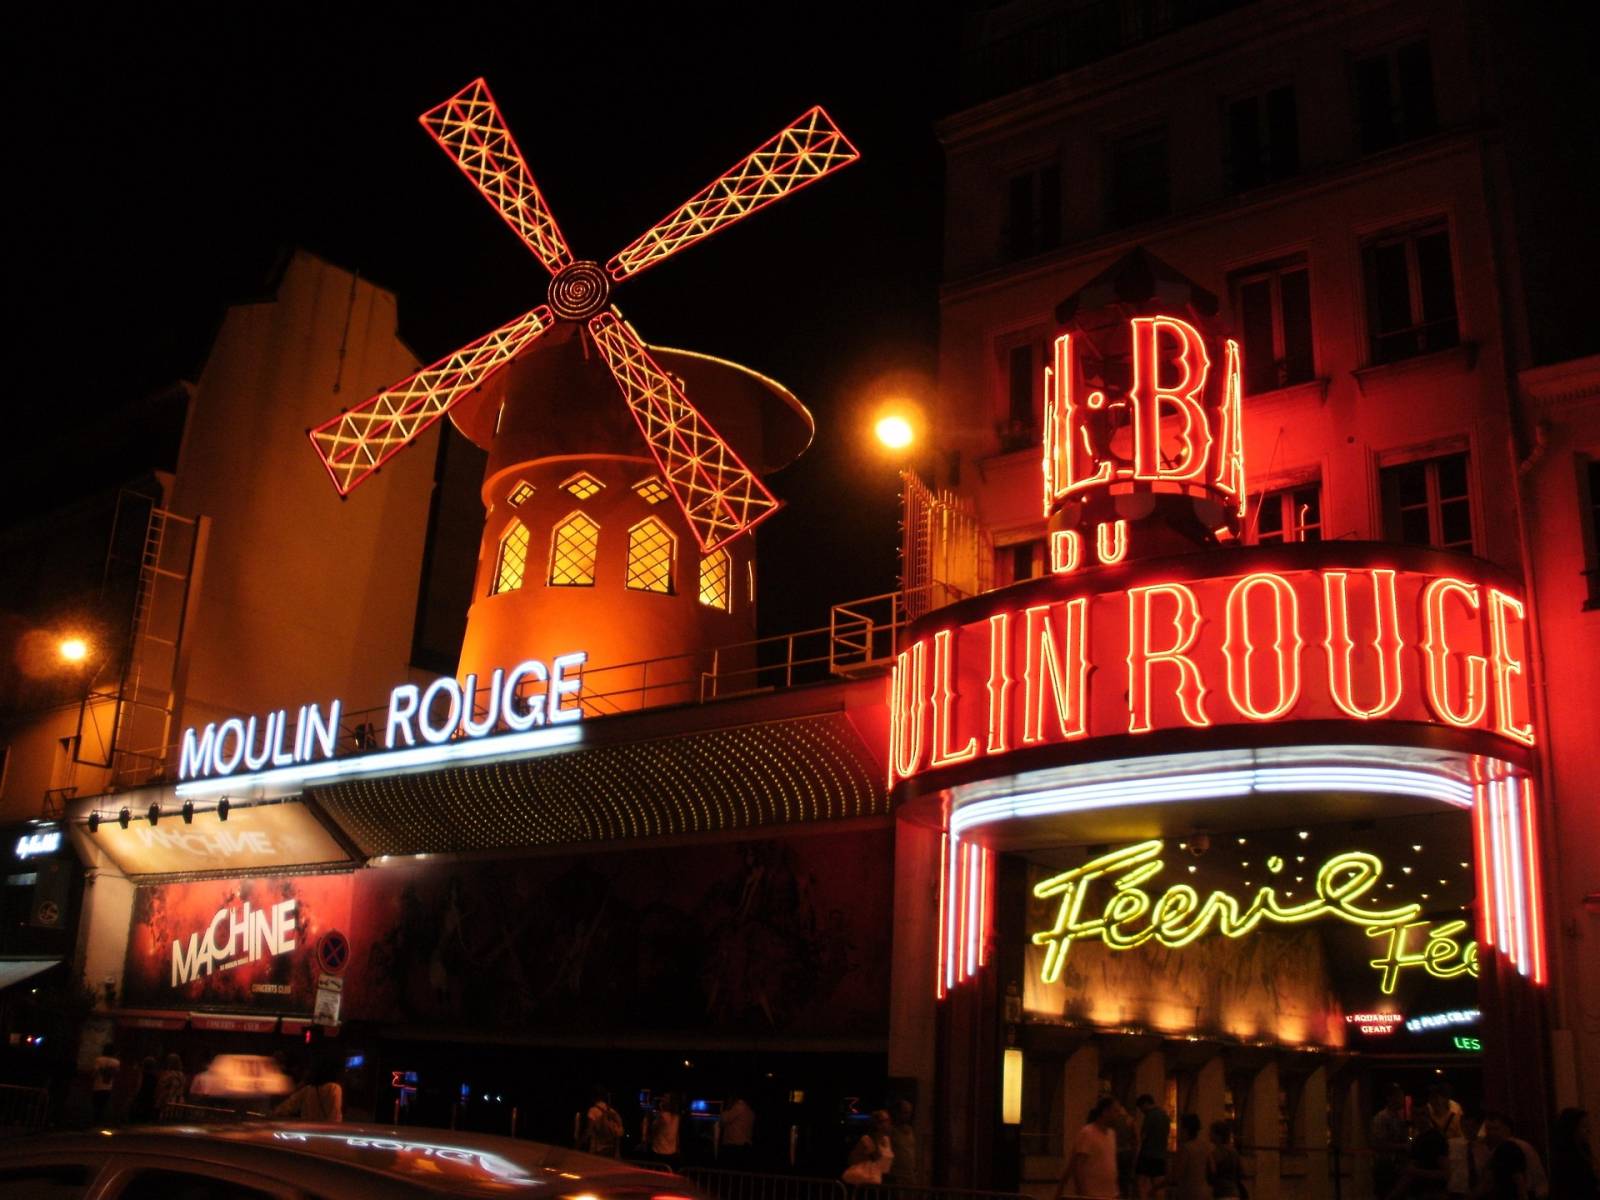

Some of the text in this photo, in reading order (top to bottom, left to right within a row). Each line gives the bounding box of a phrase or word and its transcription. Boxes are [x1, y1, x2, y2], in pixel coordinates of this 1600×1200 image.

[1050, 518, 1129, 574] DU
[1126, 568, 1536, 748] ROUGE
[178, 651, 589, 781] MOULIN ROUGE
[170, 898, 297, 988] MACHINE
[1354, 1013, 1402, 1023] AQUARIUM
[1361, 1025, 1393, 1034] GEANT
[1421, 1014, 1449, 1028] PLUS
[1453, 1036, 1481, 1050] LES
